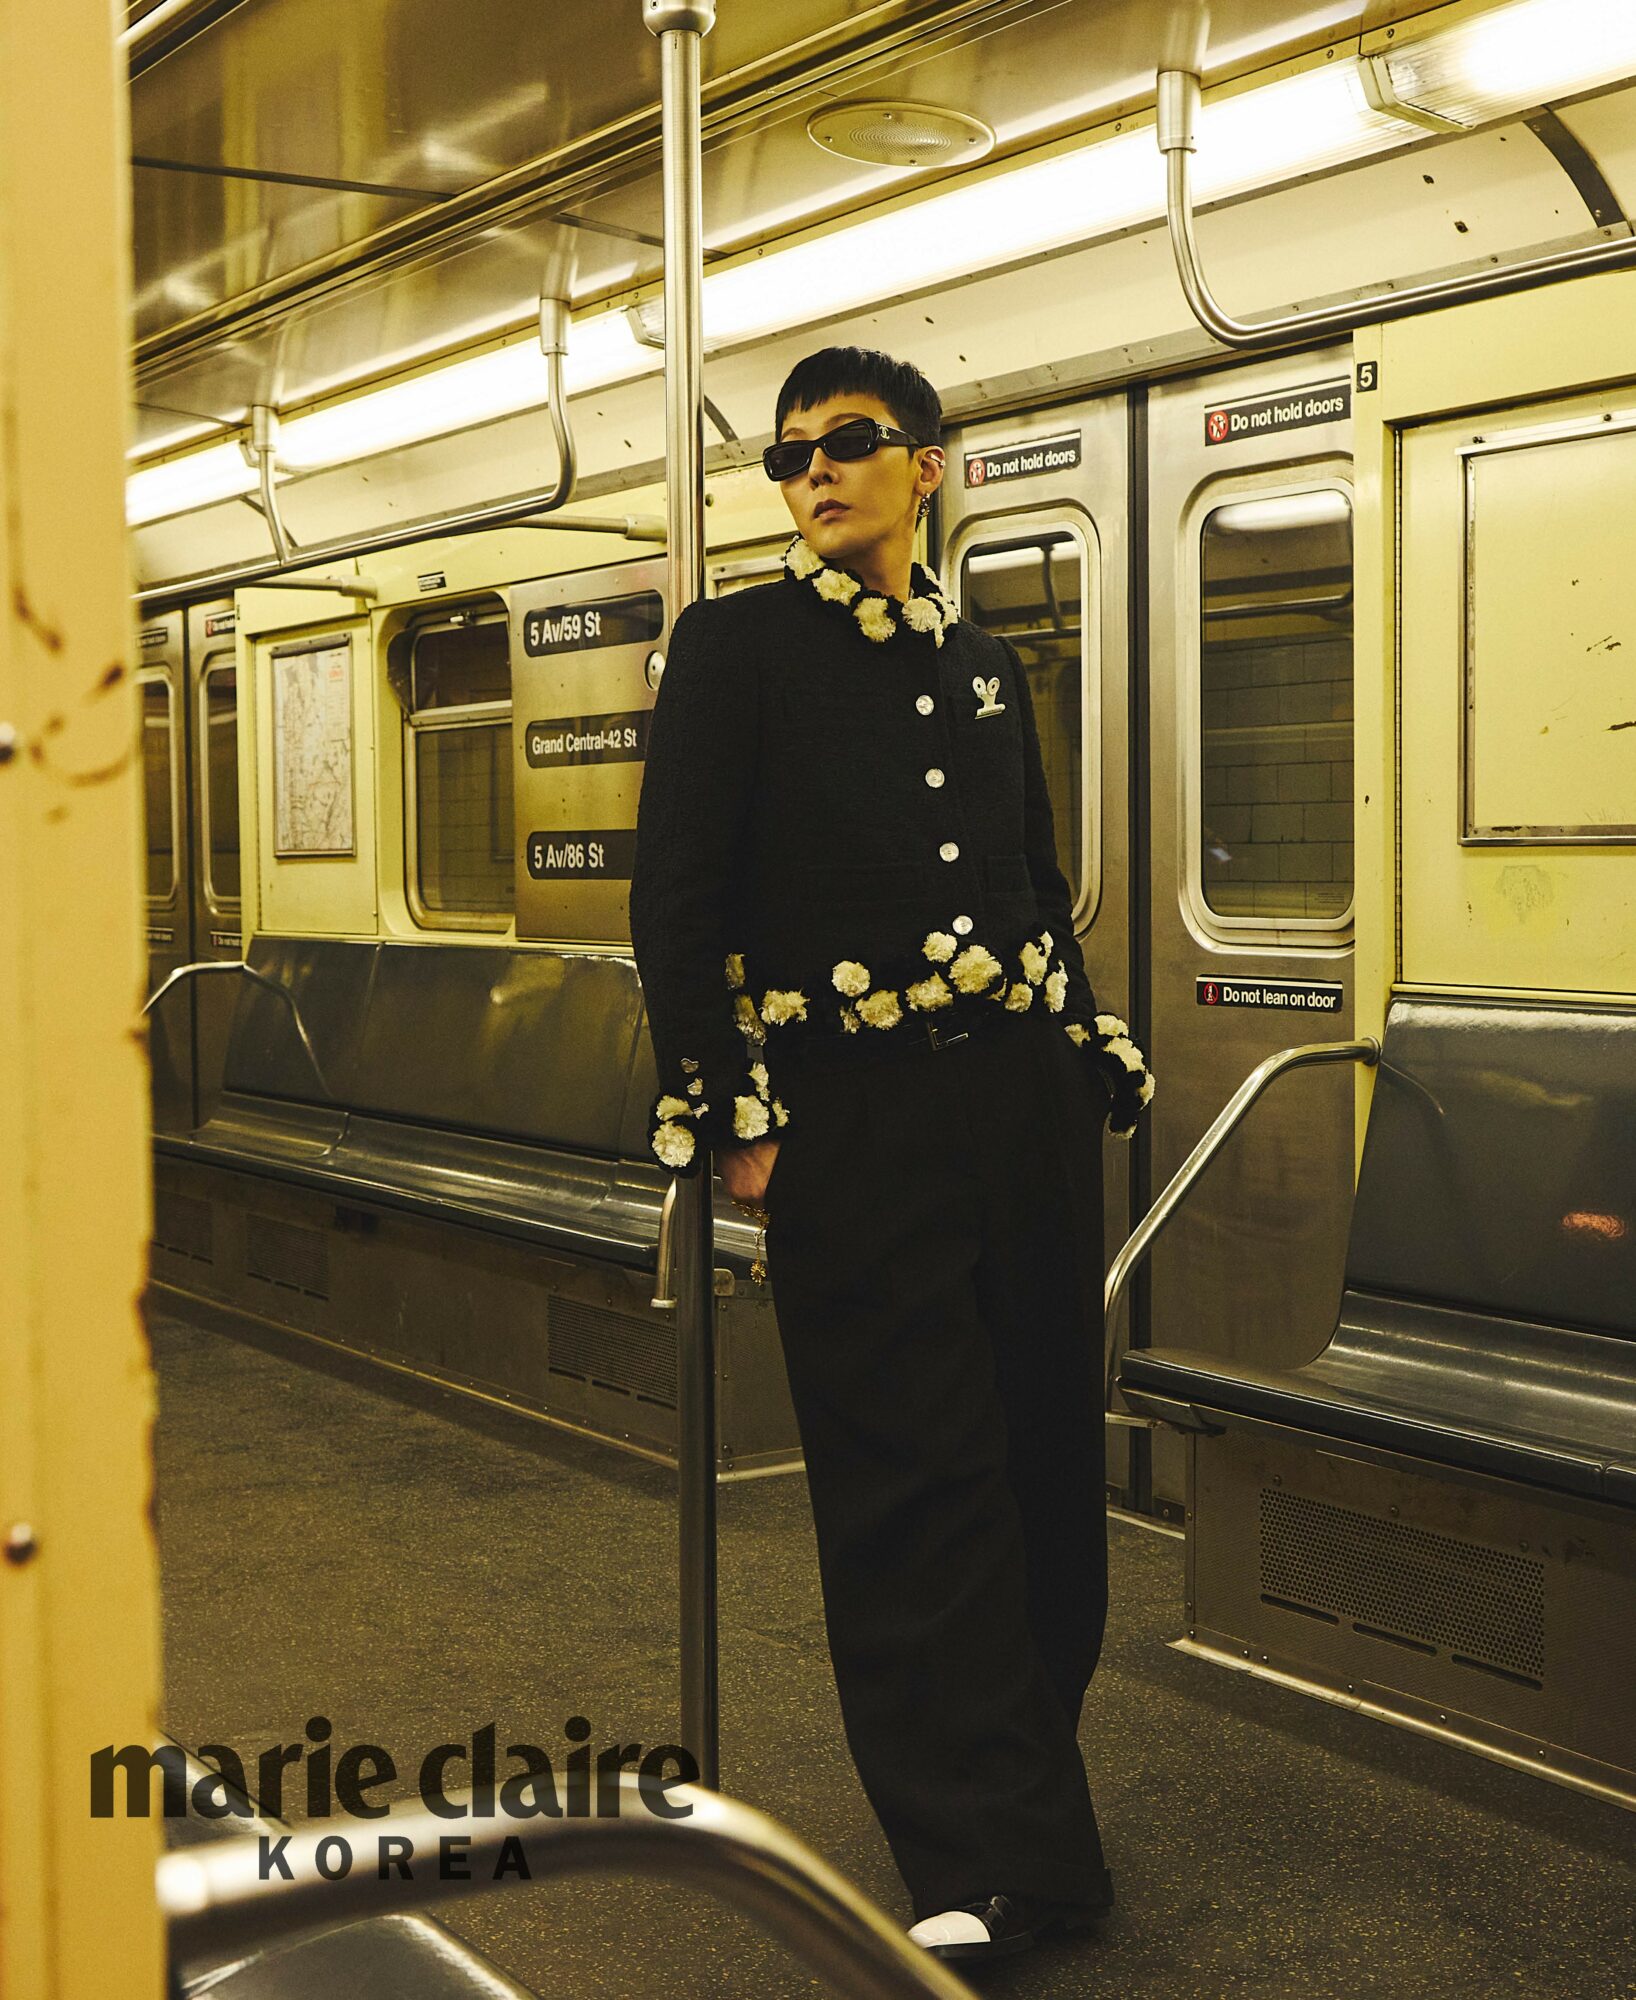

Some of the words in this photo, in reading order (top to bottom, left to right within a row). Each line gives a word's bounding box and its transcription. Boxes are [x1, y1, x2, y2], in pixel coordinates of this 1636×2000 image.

[1360, 364, 1373, 388] 5
[1230, 414, 1248, 431] Do
[1251, 409, 1272, 428] not
[1274, 402, 1303, 423] hold
[1305, 397, 1344, 417] doors
[986, 462, 1001, 478] Do
[1002, 458, 1019, 475] not
[1020, 453, 1043, 471] hold
[1045, 449, 1076, 467] doors
[530, 621, 540, 646] 5
[542, 614, 581, 644] Av/59
[584, 610, 601, 638] St
[532, 733, 563, 755] Grand
[566, 728, 621, 752] Central-42
[623, 727, 637, 748] St
[534, 845, 543, 869] 5
[545, 843, 584, 868] Av/86
[588, 842, 604, 868] St
[1223, 986, 1240, 1002] Do
[1241, 989, 1260, 1004] not
[1262, 988, 1288, 1005] lean
[1289, 993, 1305, 1006] on
[1307, 991, 1336, 1008] door
